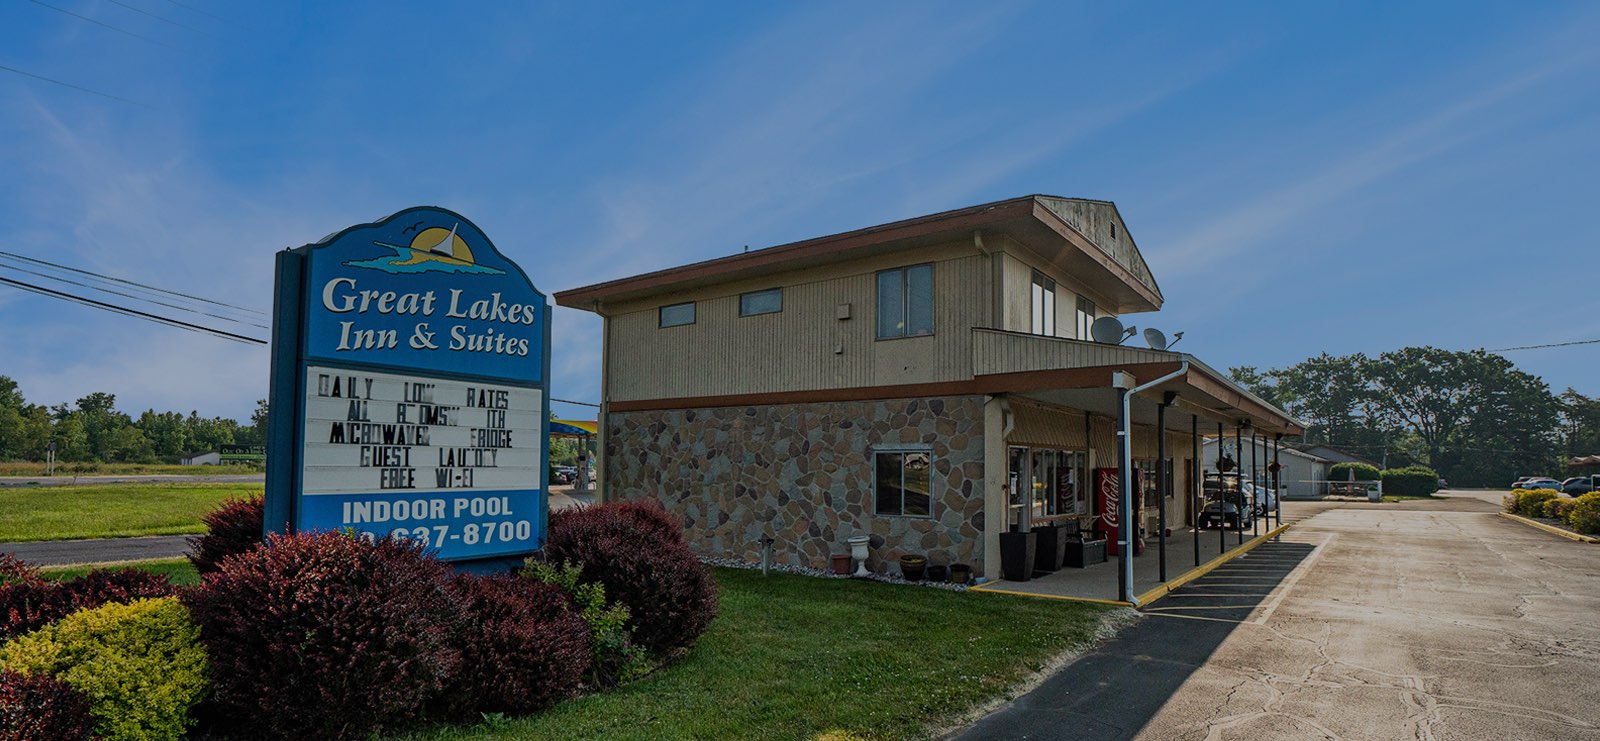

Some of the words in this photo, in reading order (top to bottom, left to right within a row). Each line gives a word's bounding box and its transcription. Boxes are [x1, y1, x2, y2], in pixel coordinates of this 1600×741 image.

[322, 277, 437, 316] Great
[445, 288, 535, 325] Lakes
[335, 321, 399, 351] Inn
[409, 322, 439, 350] &
[449, 325, 529, 357] Suites
[318, 373, 374, 400] DAILY
[466, 387, 509, 410] RATES
[347, 400, 371, 423] ALL
[397, 403, 447, 425] ROMS
[470, 428, 513, 448] FRIDGE
[360, 445, 412, 468] GUEST
[439, 447, 498, 468] LAUDY
[380, 468, 417, 489] FREE
[436, 468, 474, 489] WI-FI
[342, 499, 447, 524] INDOOR
[453, 496, 513, 519] POOL
